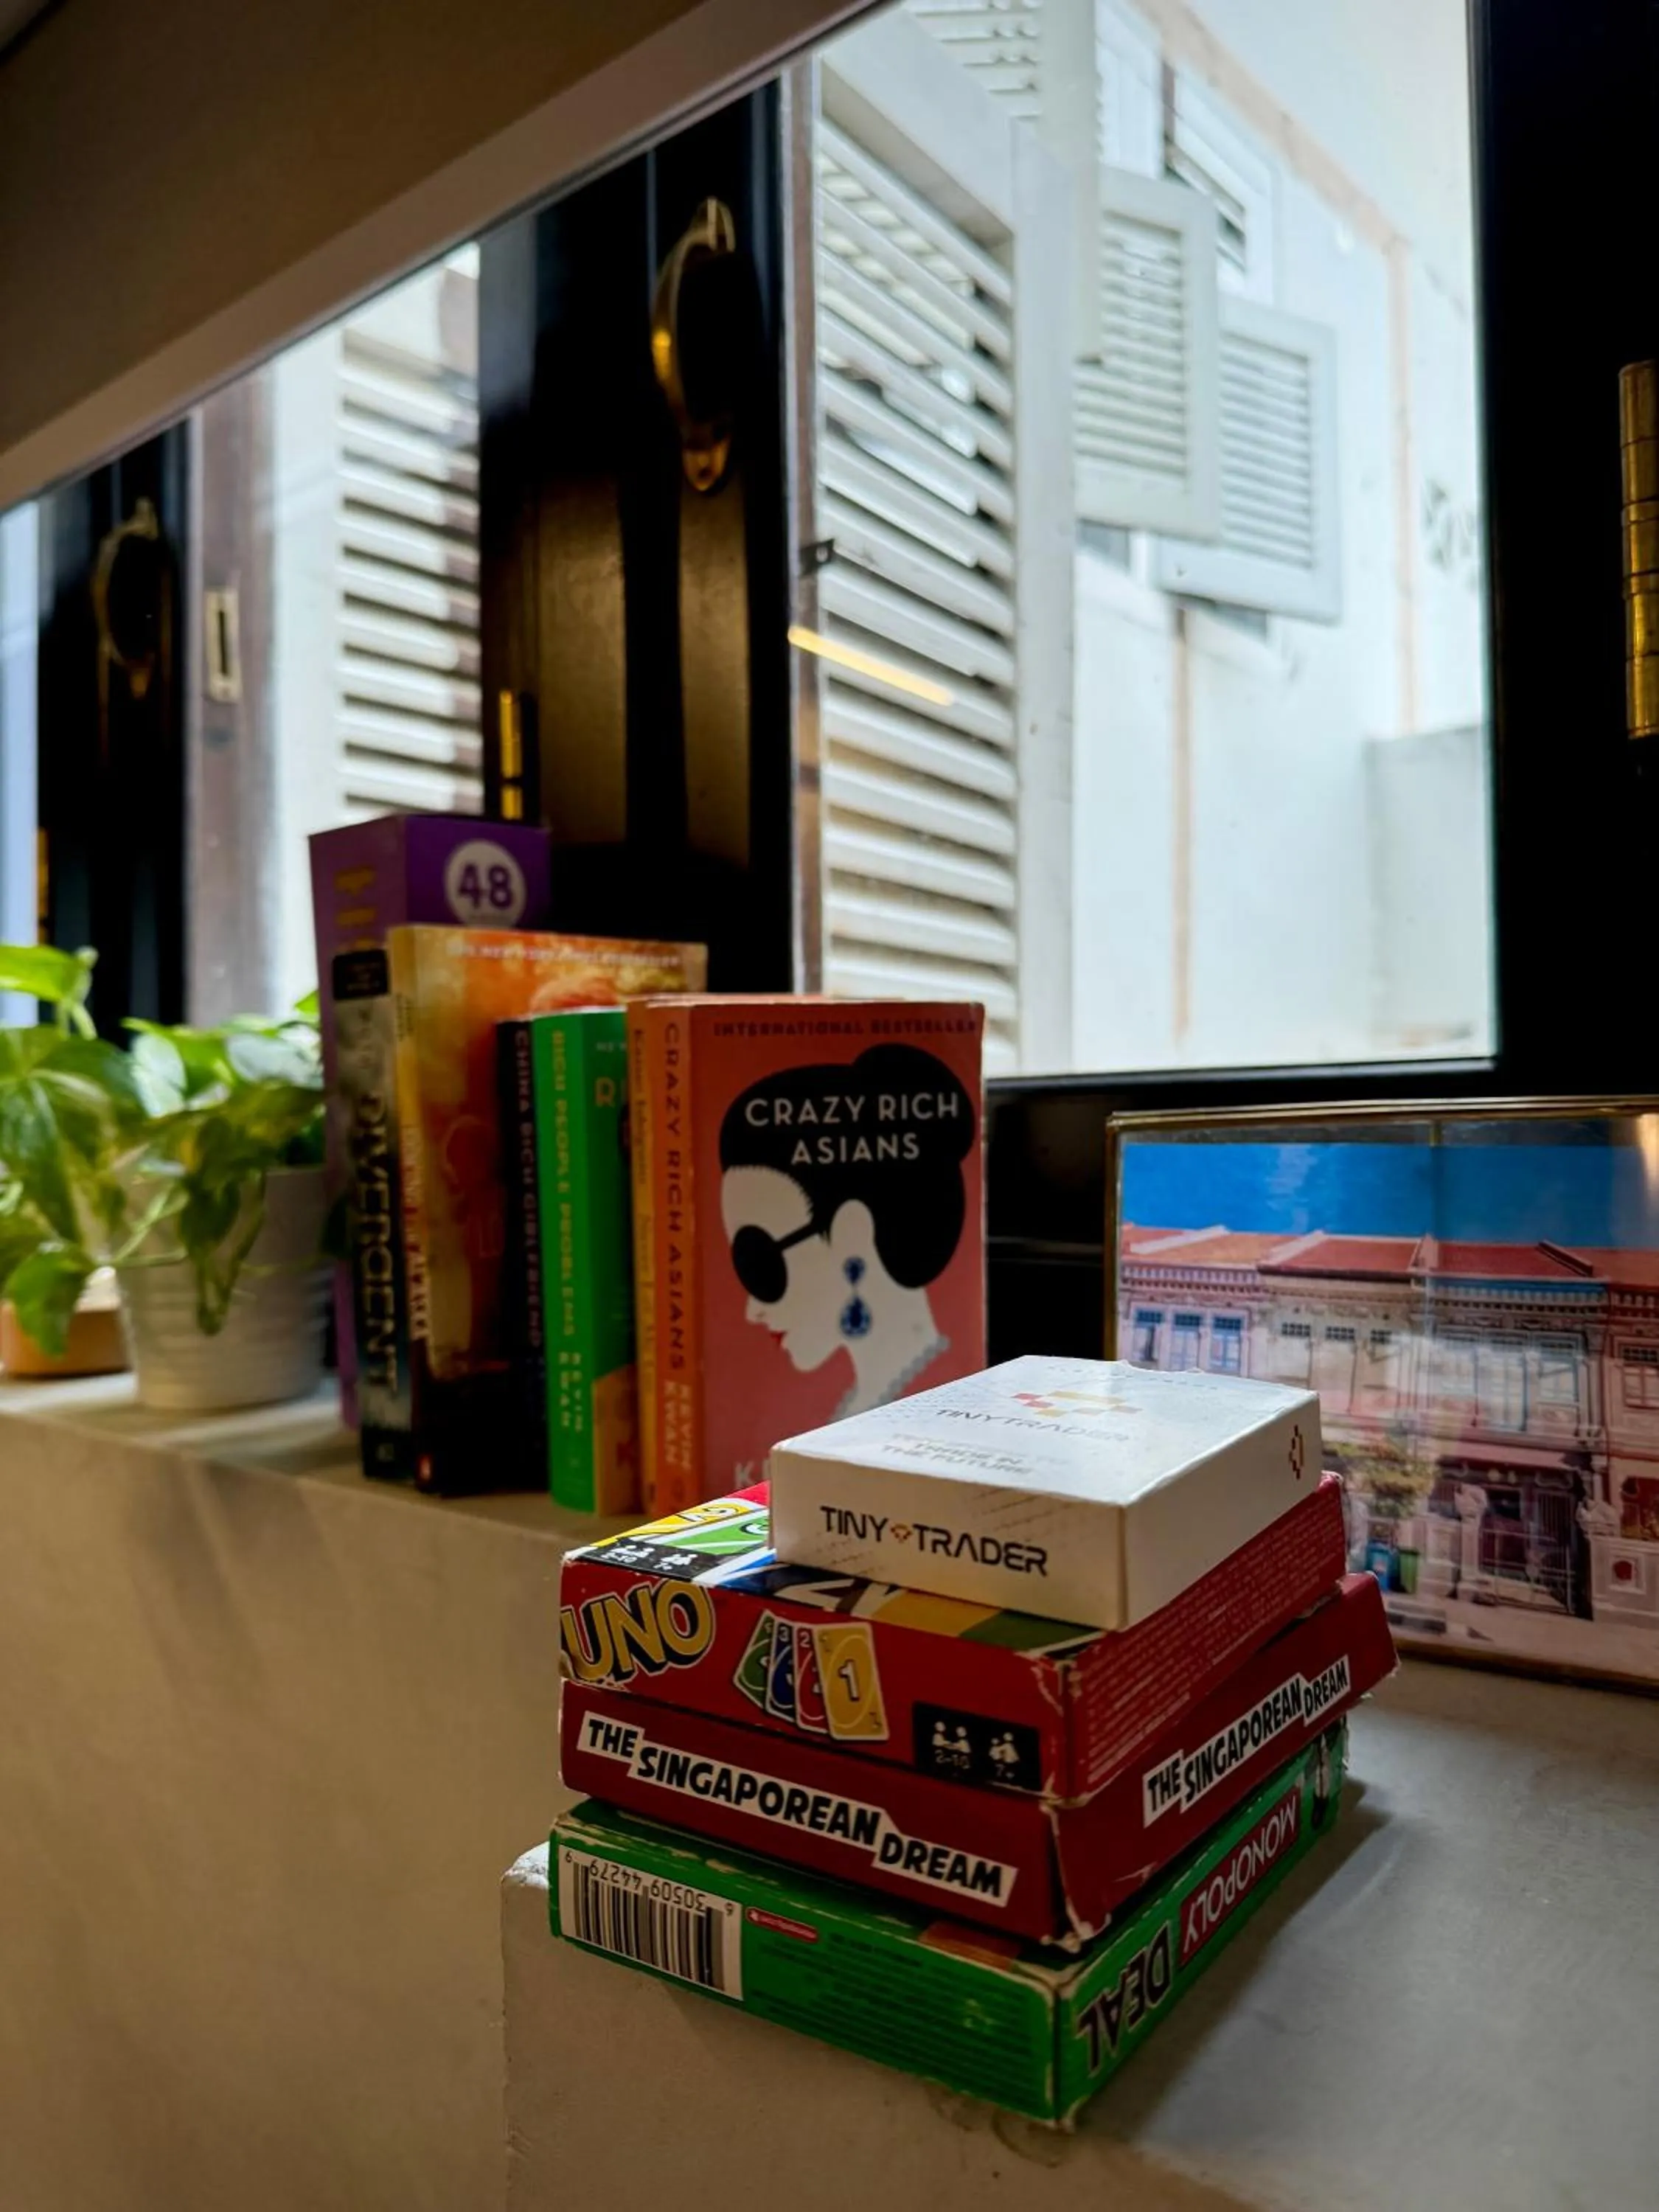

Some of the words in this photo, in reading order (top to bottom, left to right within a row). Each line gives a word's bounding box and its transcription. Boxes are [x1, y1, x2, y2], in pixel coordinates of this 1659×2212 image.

[459, 863, 513, 910] 48
[551, 1029, 567, 1091] RICH
[714, 1020, 864, 1037] INTERNATIONAL
[871, 1018, 976, 1034] BESTSELLER
[665, 1022, 682, 1138] CRAZY
[742, 1093, 866, 1127] CRAZY
[877, 1091, 959, 1122] RICH
[554, 1098, 571, 1194] PEOPLE
[790, 1131, 921, 1166] ASIANS
[667, 1150, 684, 1232] RICH
[355, 1091, 398, 1392] DIVERGENT
[558, 1202, 575, 1336] PROBLEMS
[668, 1243, 685, 1370] ASIANS
[665, 1380, 678, 1466] KWAN
[679, 1384, 692, 1471] KEVIN
[819, 1505, 888, 1543] TINY
[911, 1523, 1048, 1577] TRADER
[560, 1578, 715, 1686] UNO
[779, 1625, 791, 1644] 3
[799, 1630, 811, 1648] 2
[838, 1659, 860, 1703] 1
[1147, 1755, 1181, 1813] THE
[1182, 1677, 1302, 1803] SINGAPOREAN
[1303, 1660, 1349, 1718] DREAM
[588, 1719, 639, 1759] THE
[637, 1746, 882, 1846] SINGAPOREAN
[878, 1832, 1003, 1898] DREAM
[565, 1851, 574, 1865] 9
[589, 1858, 643, 1890] 44279
[1183, 1795, 1297, 1954] MONOPOLY
[650, 1886, 708, 1912] 30509
[725, 1902, 734, 1917] 6
[1076, 1920, 1171, 2078] DEAL
